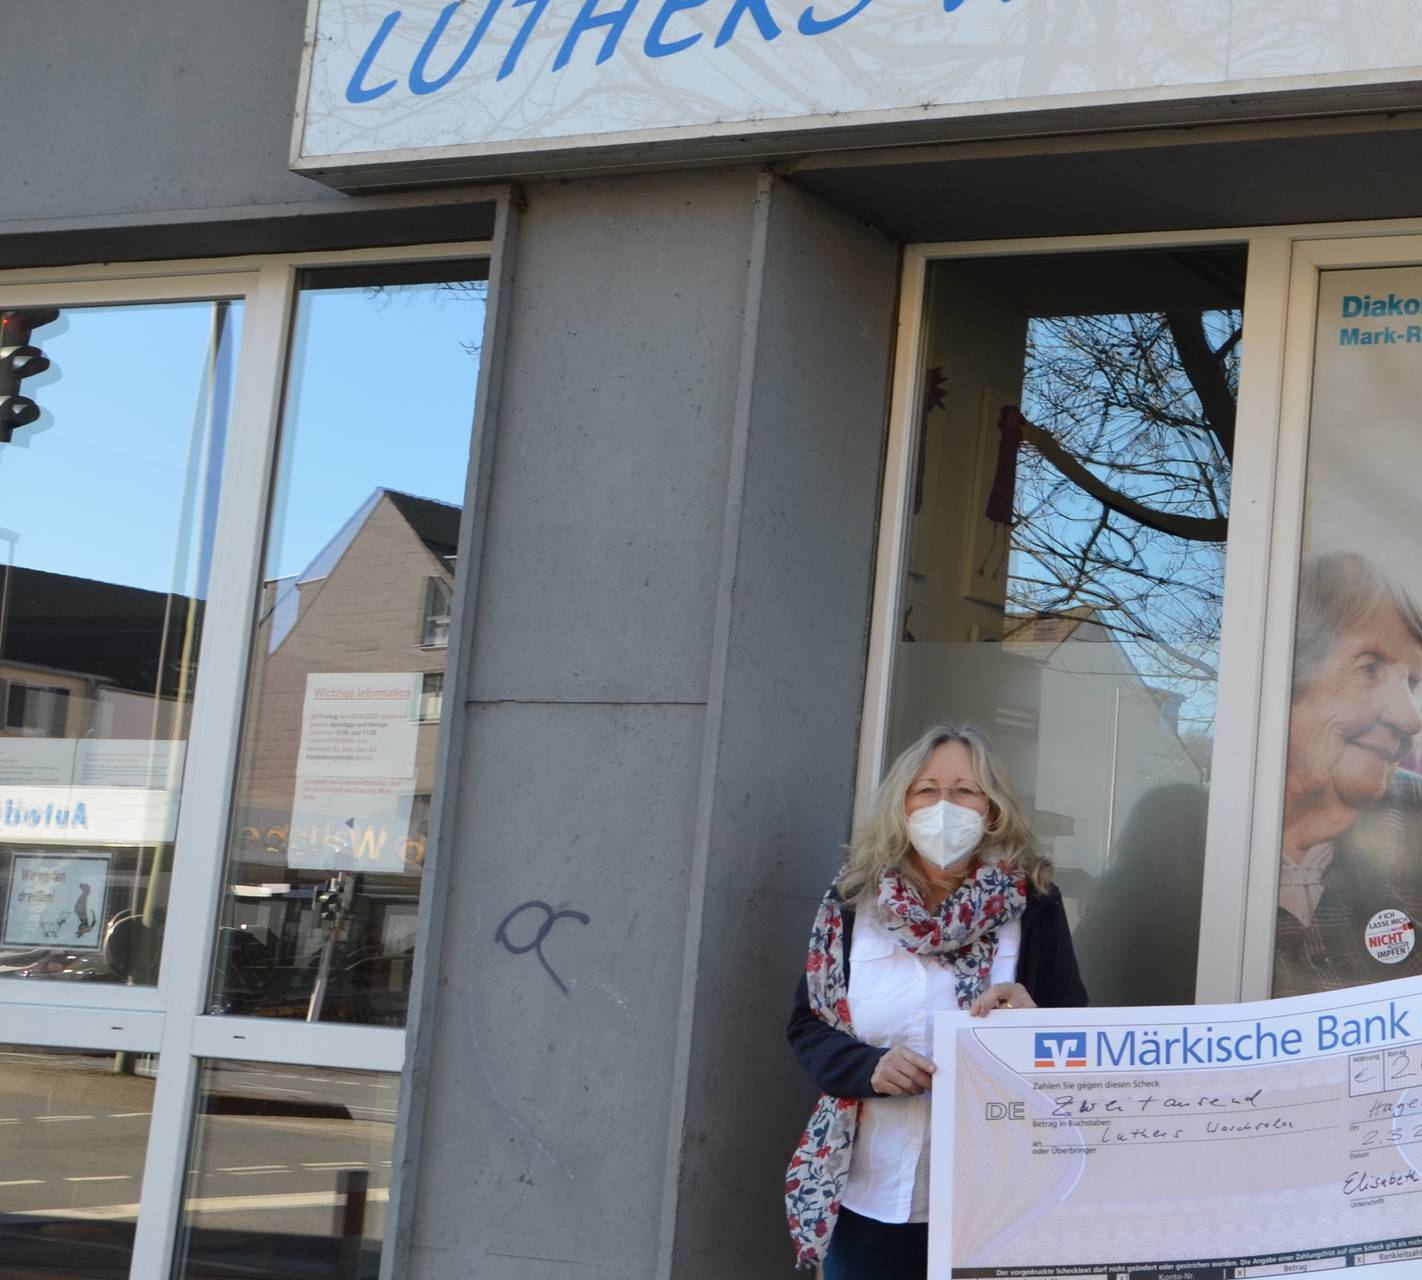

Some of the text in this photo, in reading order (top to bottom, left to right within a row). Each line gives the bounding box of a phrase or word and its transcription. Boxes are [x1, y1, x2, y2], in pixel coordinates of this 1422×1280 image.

[1370, 921, 1390, 929] LASSE
[1369, 932, 1403, 948] NICHT
[1096, 1022, 1303, 1068] Märkische
[1317, 1002, 1411, 1051] Bank
[1033, 1082, 1061, 1090] Zahlen
[1077, 1082, 1102, 1091] gegen
[1105, 1081, 1130, 1089] diesen
[1133, 1080, 1160, 1088] Scheck
[986, 1102, 1025, 1120] DE
[1033, 1120, 1057, 1129] Betrag
[1068, 1119, 1112, 1127] Buchstaben
[1051, 1146, 1097, 1155] Überbringer
[1350, 1152, 1370, 1160] Datum
[1343, 1170, 1419, 1195] Elisabeth
[1010, 1268, 1054, 1277] vorgedruckte
[1175, 1262, 1210, 1270] gestrichen
[1211, 1260, 1238, 1268] werden.
[1252, 1257, 1277, 1265] Angabe
[1295, 1251, 1336, 1260] Zahlungsfrist
[1363, 1244, 1384, 1252] Scheck
[1386, 1242, 1397, 1250] gilt
[1284, 1265, 1308, 1273] Betrag
